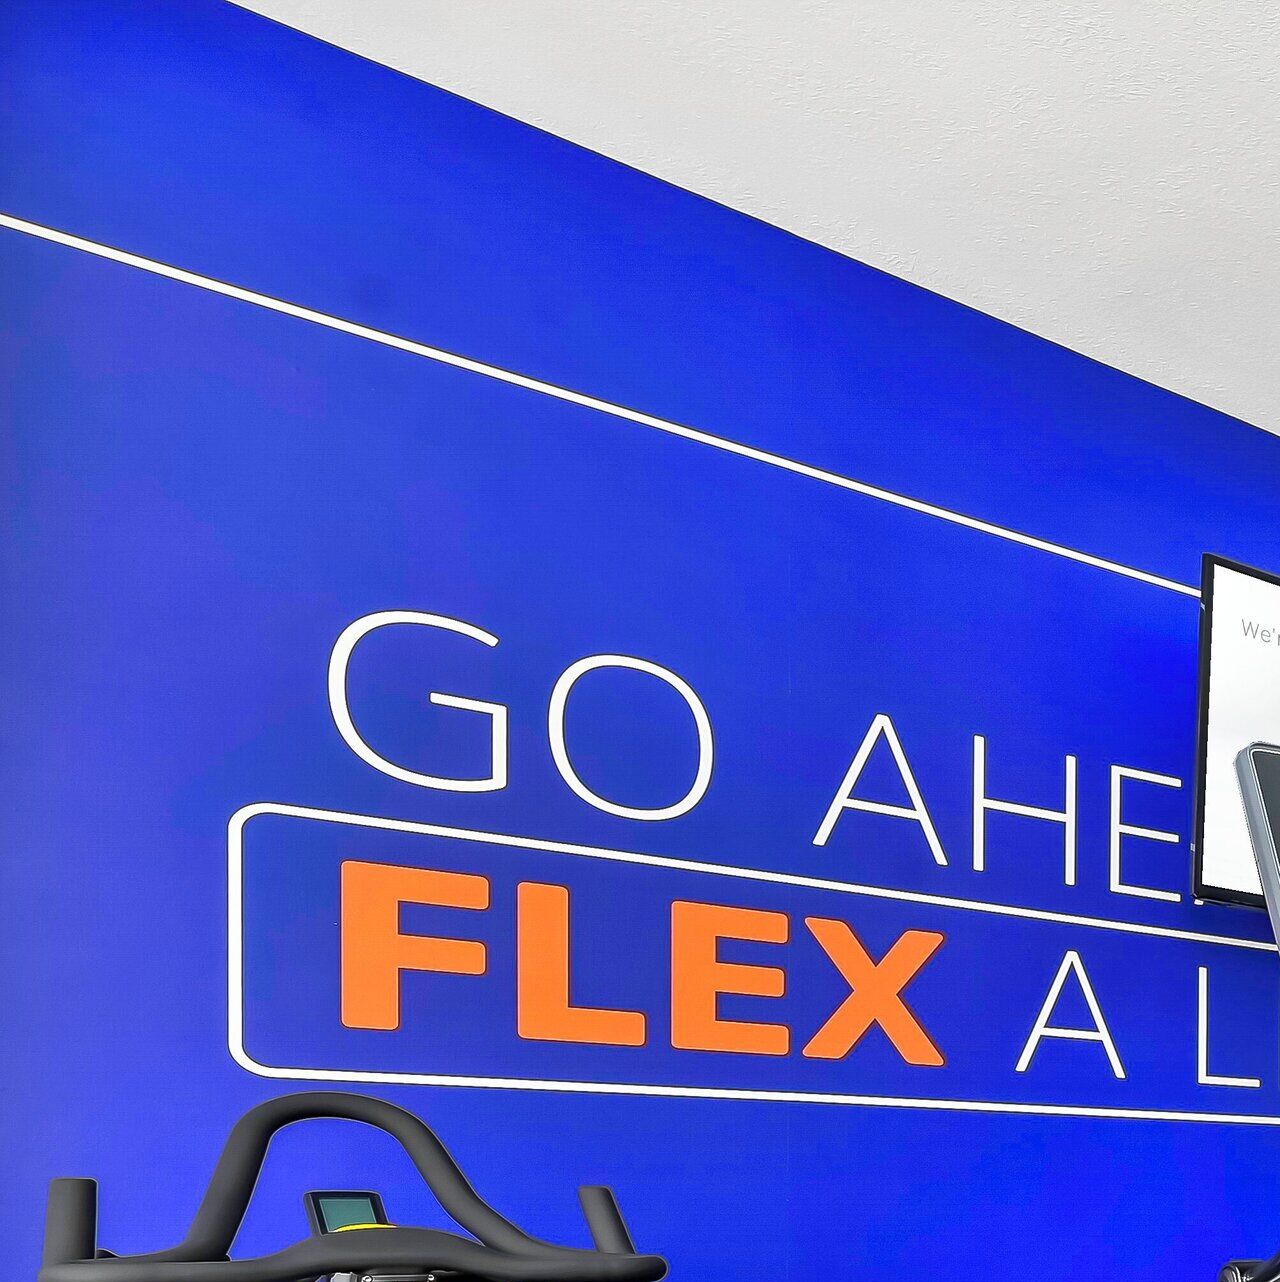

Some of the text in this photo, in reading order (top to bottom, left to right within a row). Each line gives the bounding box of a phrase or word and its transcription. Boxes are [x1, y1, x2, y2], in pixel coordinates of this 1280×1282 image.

[327, 610, 1181, 903] GO AHE
[340, 860, 945, 1066] FLEX
[1014, 950, 1127, 1080] A
